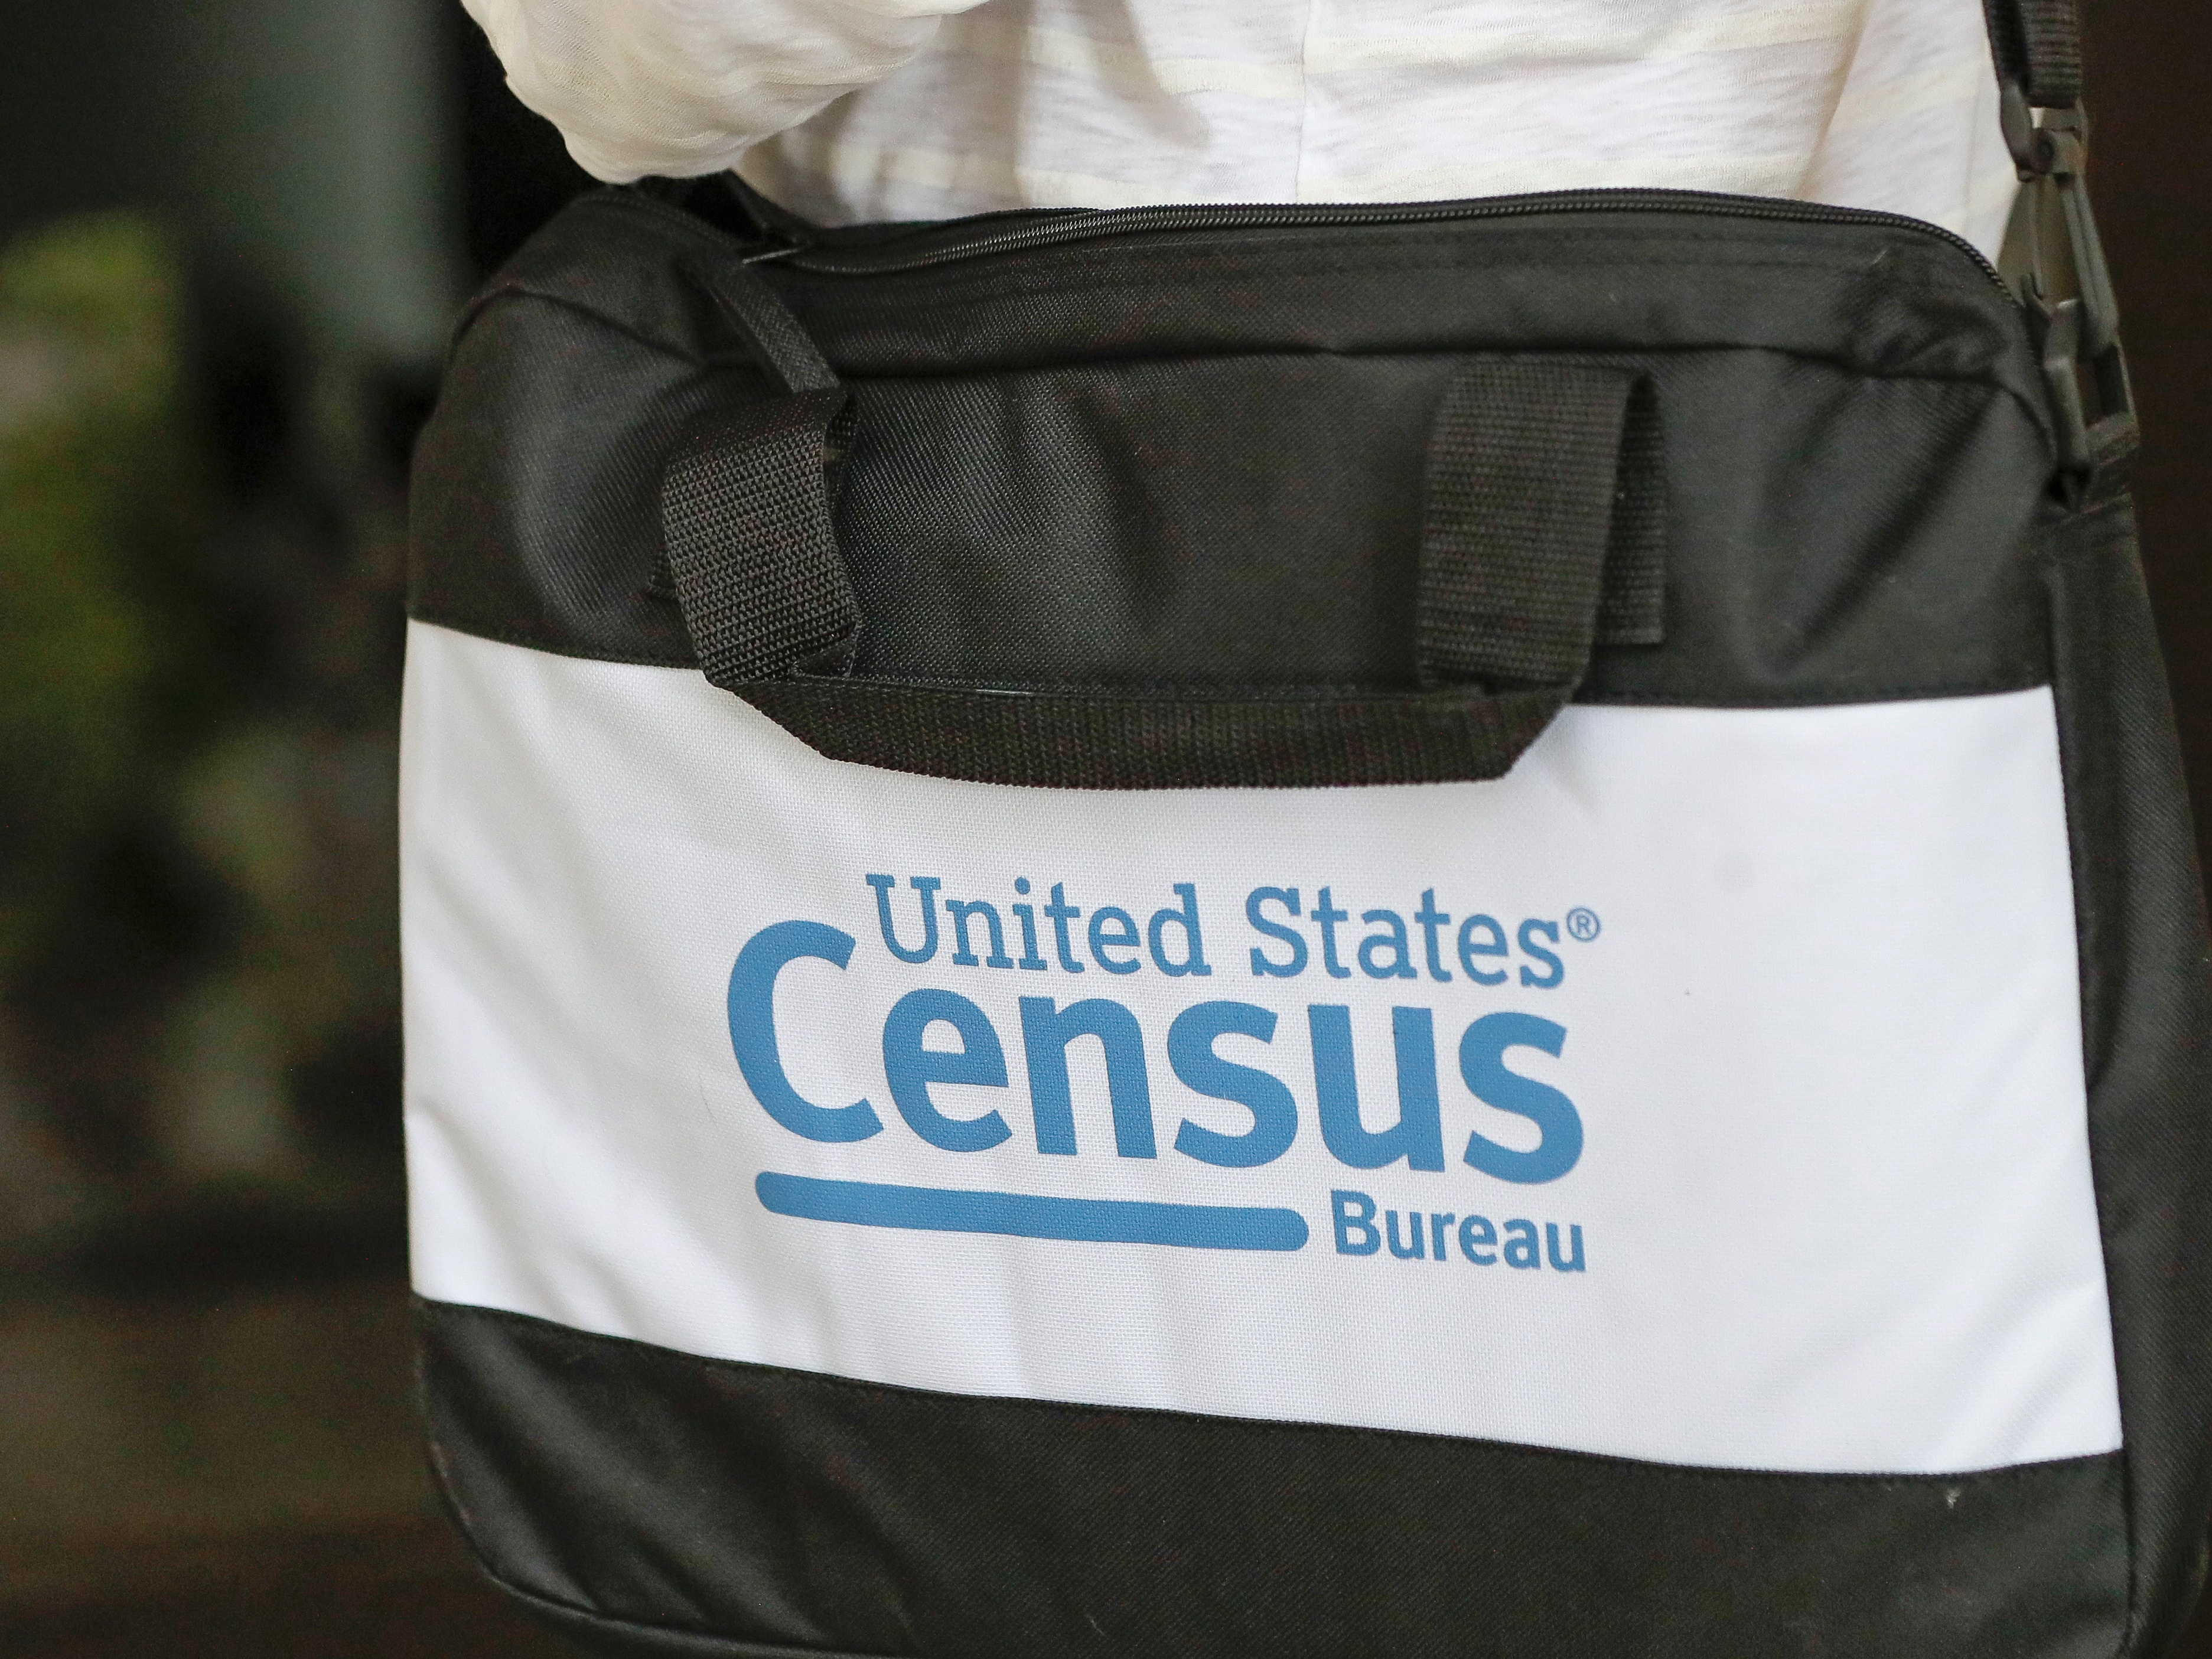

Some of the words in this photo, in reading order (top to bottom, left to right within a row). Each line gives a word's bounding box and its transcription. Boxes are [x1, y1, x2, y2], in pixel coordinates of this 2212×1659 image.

[866, 873, 1212, 977] United
[727, 919, 1584, 1184] Census
[1331, 1189, 1586, 1273] Bureau
